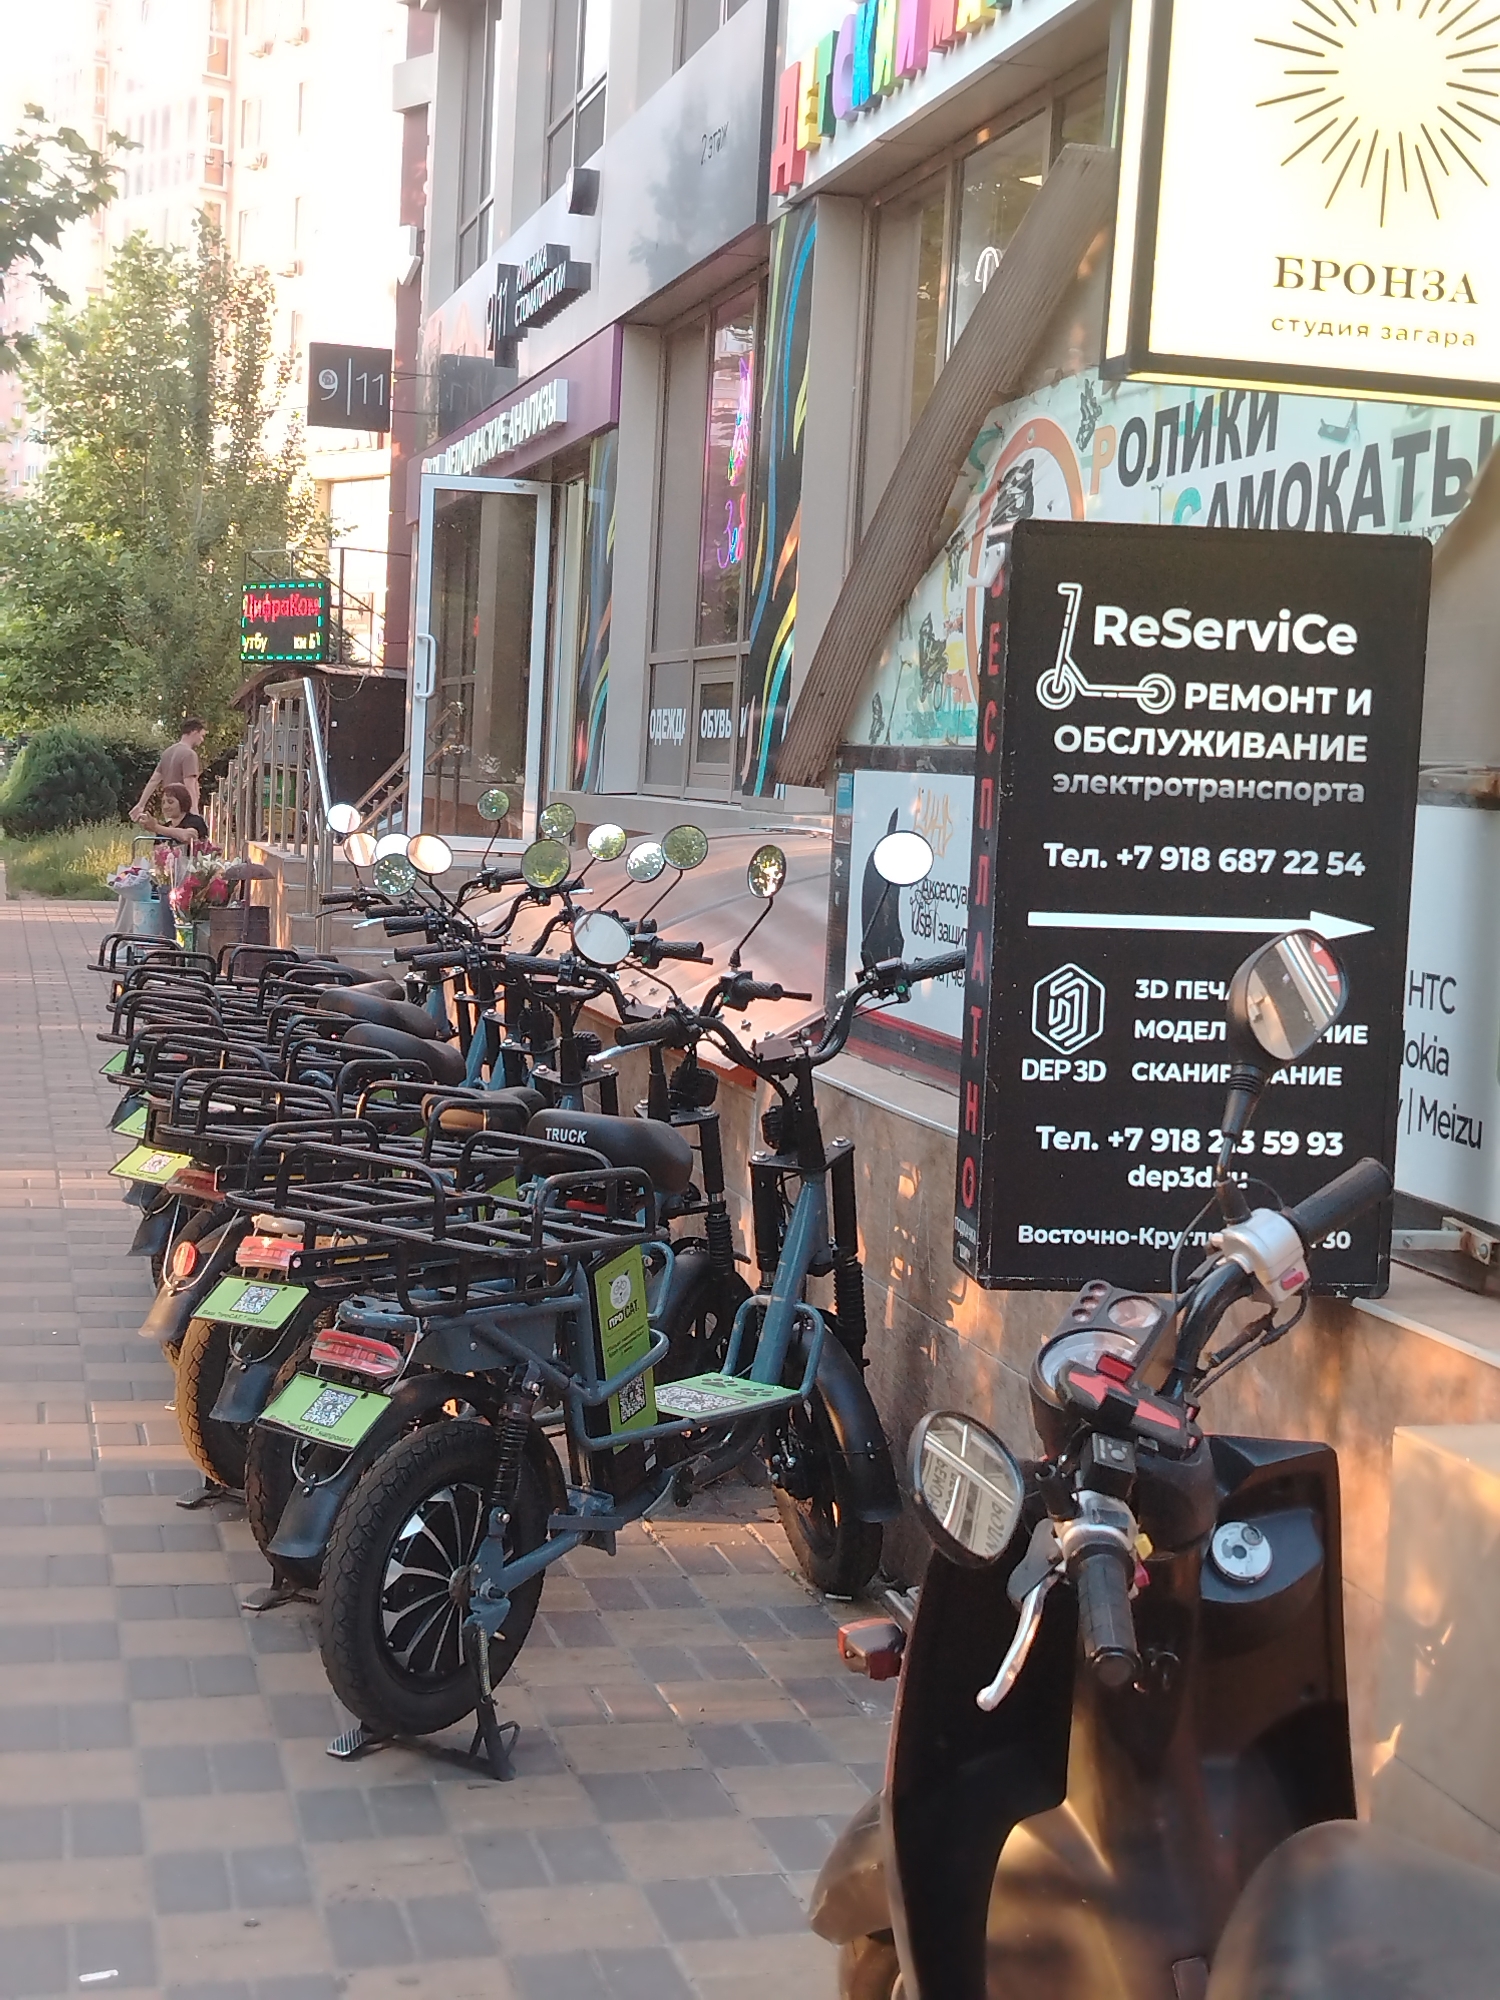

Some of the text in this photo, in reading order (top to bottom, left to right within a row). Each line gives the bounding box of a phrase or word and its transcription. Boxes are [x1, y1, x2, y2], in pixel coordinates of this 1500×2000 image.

[515, 244, 548, 293] КЛИНИКА
[1273, 256, 1479, 305] БРОНЗА
[514, 260, 567, 328] СТОМАТОЛОГИИ
[1271, 317, 1476, 349] студия загара
[507, 380, 560, 447] АНАЛИЗЫ
[1090, 389, 1279, 496] РОЛИКИ
[1093, 605, 1359, 656] ReServiCe
[1185, 682, 1372, 716] РЕМОНТ И
[700, 708, 732, 739] ОБУВЬ
[1053, 725, 1369, 763] ОБСЛУЖИВАНИЕ
[1052, 773, 1366, 806] электротранспорта
[1043, 842, 1366, 877] Тел. +7 918 687 22 54
[1135, 979, 1231, 1001] 3D ПЕЧ
[1408, 970, 1457, 1014] HTC
[545, 1127, 588, 1145] TRUCK
[1417, 1095, 1483, 1150] Meizu
[1036, 1126, 1344, 1157] Тел. +7 918 23 59 93
[1127, 1164, 1249, 1192] dep3d.u
[608, 1311, 624, 1329] ПРО
